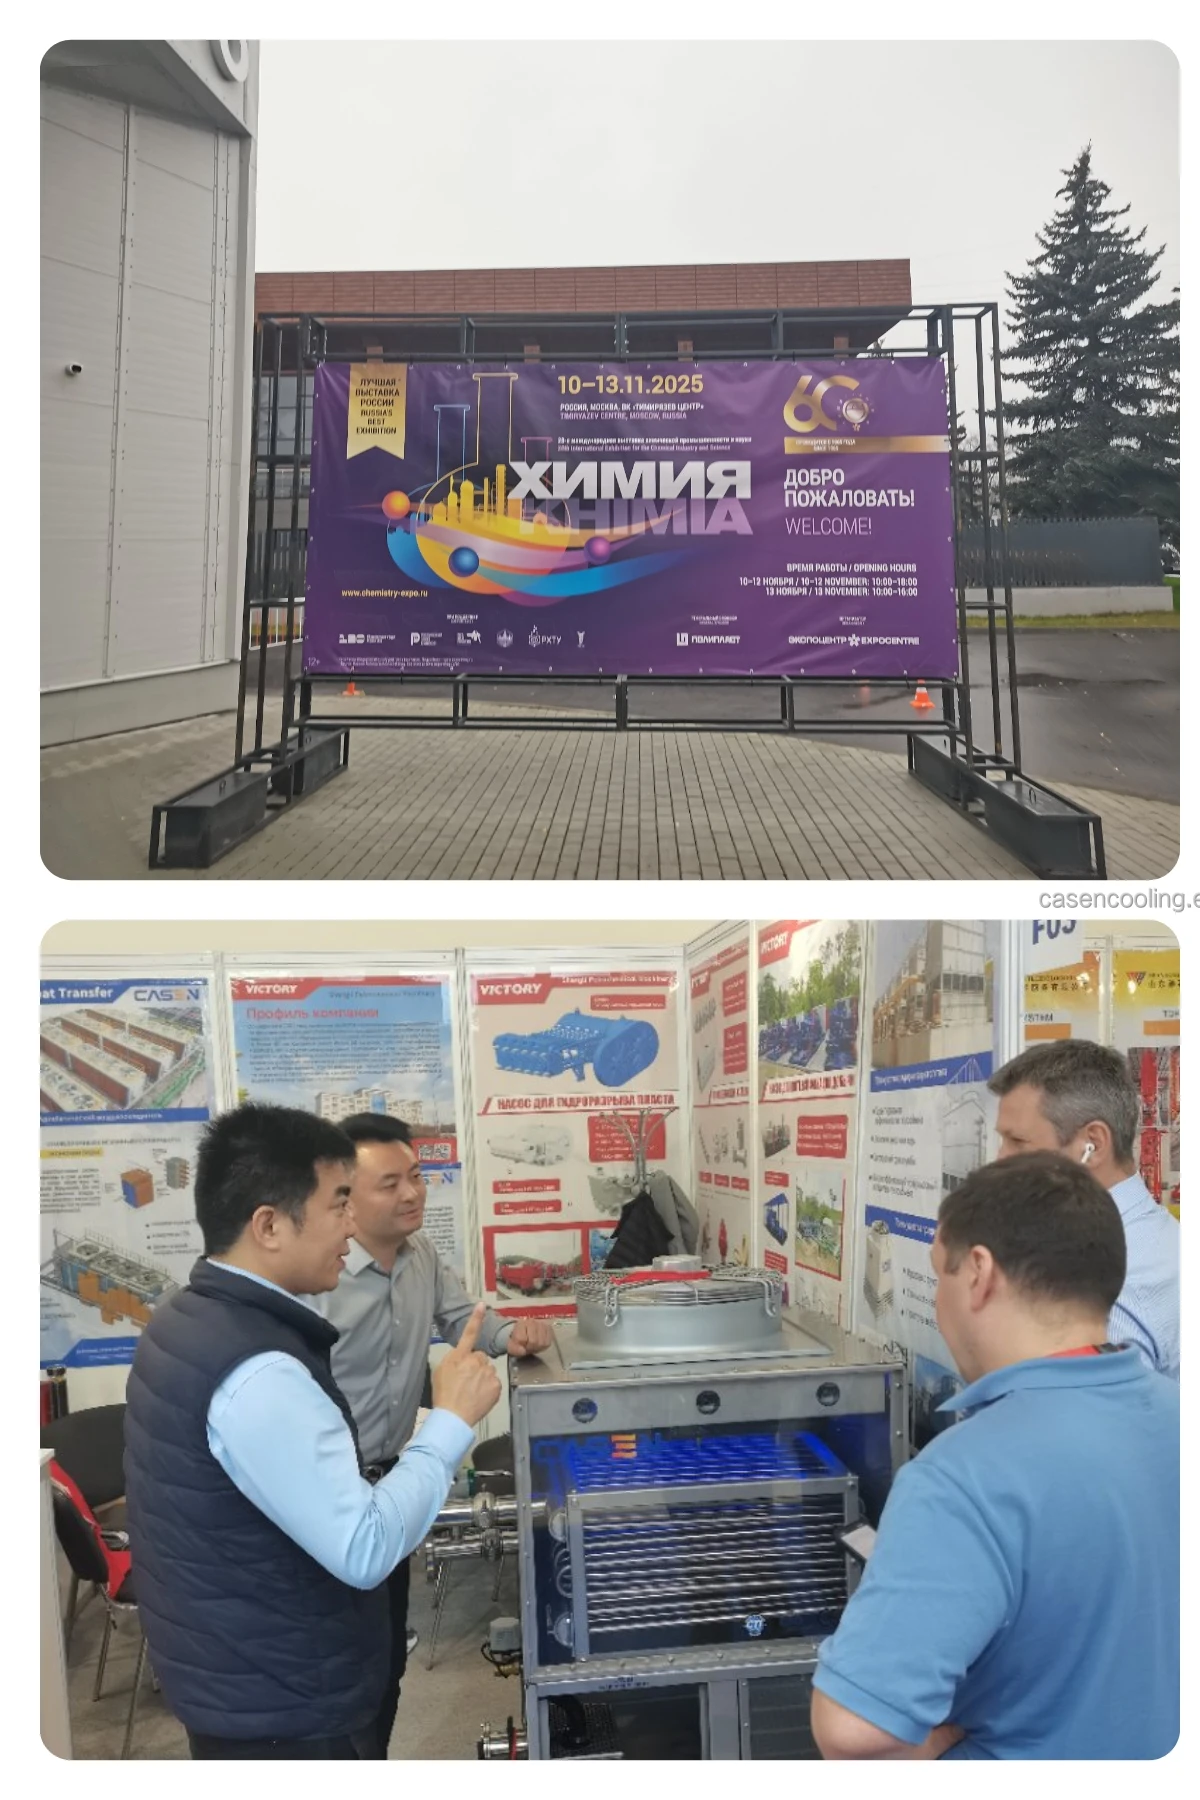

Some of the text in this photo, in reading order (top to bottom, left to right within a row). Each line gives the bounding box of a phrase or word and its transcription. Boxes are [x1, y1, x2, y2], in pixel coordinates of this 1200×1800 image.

[360, 378, 396, 386] ЛУЧШАЯ
[355, 388, 400, 397] ВЫСТАВКА
[360, 399, 394, 407] РОССИИ
[507, 461, 751, 499] ХИМИЯ
[784, 469, 844, 489] ДОБРО
[785, 489, 915, 507] ПОЖАЛОВАТЬ!
[519, 498, 753, 535] KHIMIA
[785, 517, 872, 536] WELCOME!
[787, 564, 917, 572] ВРЕМЯ РАБОТЫ OPENING HOURS
[763, 577, 793, 586] НОЯБРЯ
[341, 588, 428, 598] www.chemistry-expo.ru
[765, 587, 774, 596] 13
[776, 587, 807, 596] НОЯБРЯ
[814, 587, 823, 596] 13
[58, 986, 113, 999] Transfer
[245, 984, 298, 995] VICTORY
[480, 983, 542, 995] VICTORY
[133, 989, 200, 1002] CASEN
[246, 1007, 379, 1020] Профиль компании
